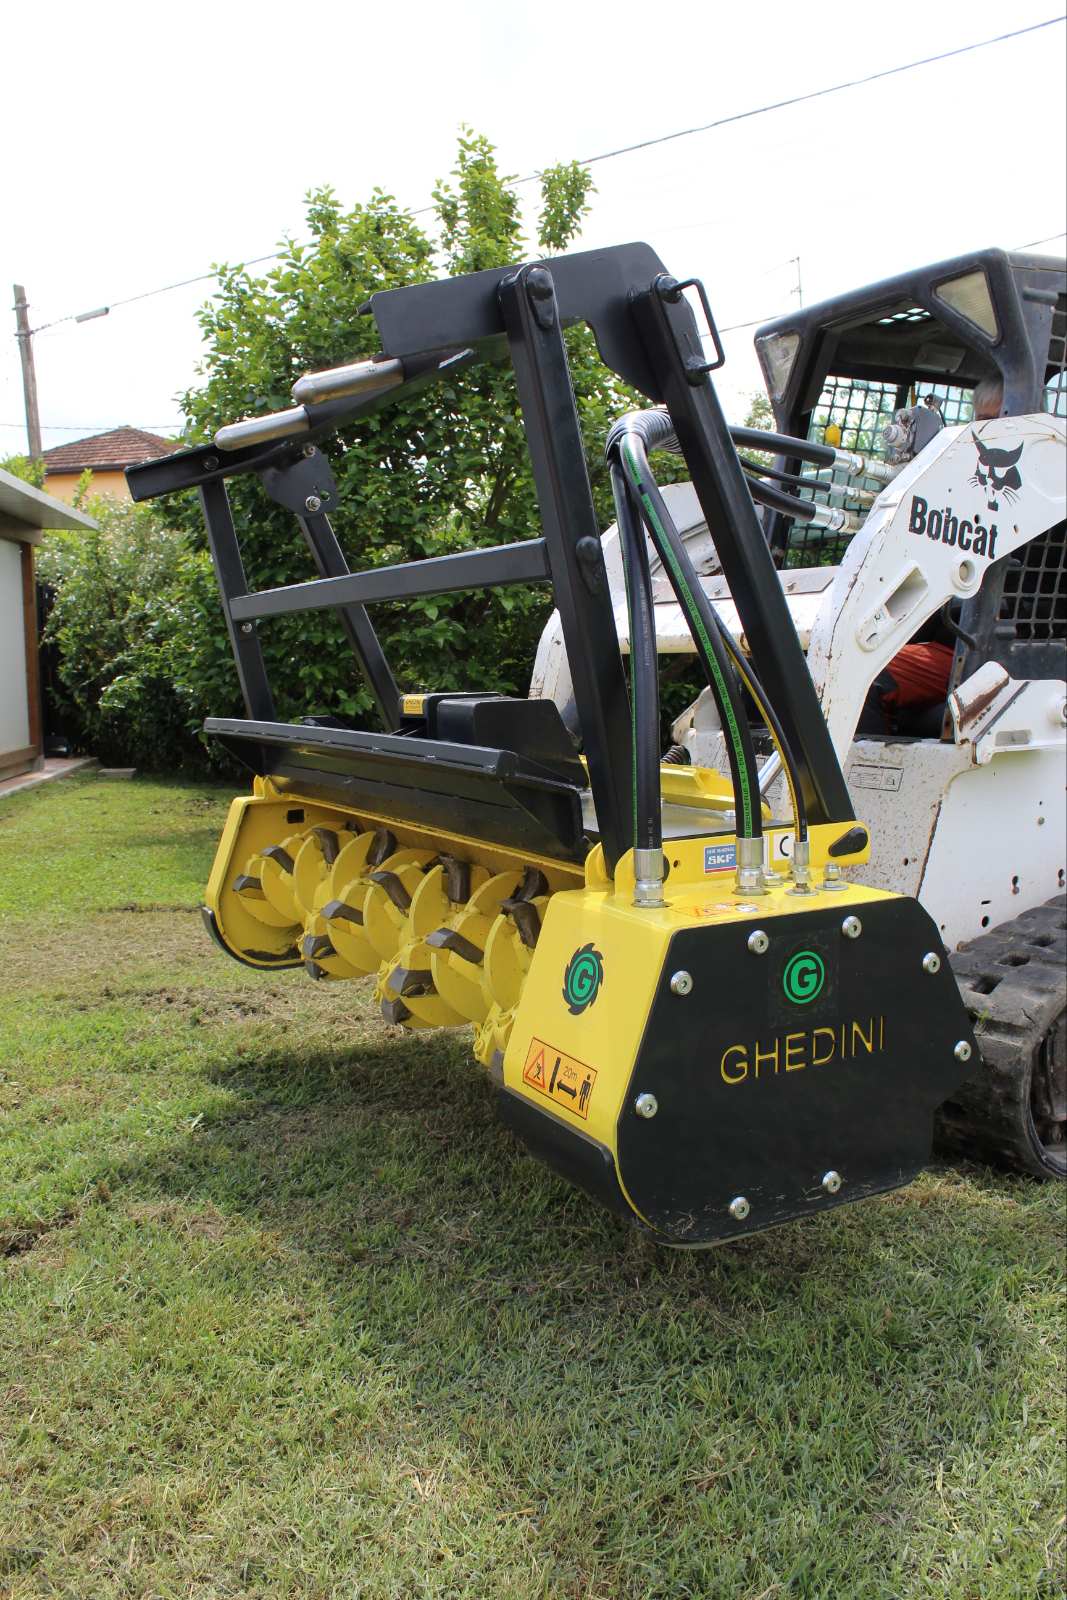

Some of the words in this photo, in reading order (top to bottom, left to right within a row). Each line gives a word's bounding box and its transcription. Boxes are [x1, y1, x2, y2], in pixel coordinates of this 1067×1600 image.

[908, 495, 998, 560] Bobcat
[708, 853, 735, 865] SKF
[790, 958, 818, 997] G
[720, 1015, 884, 1085] GHEDINI
[563, 1065, 578, 1082] 20m
